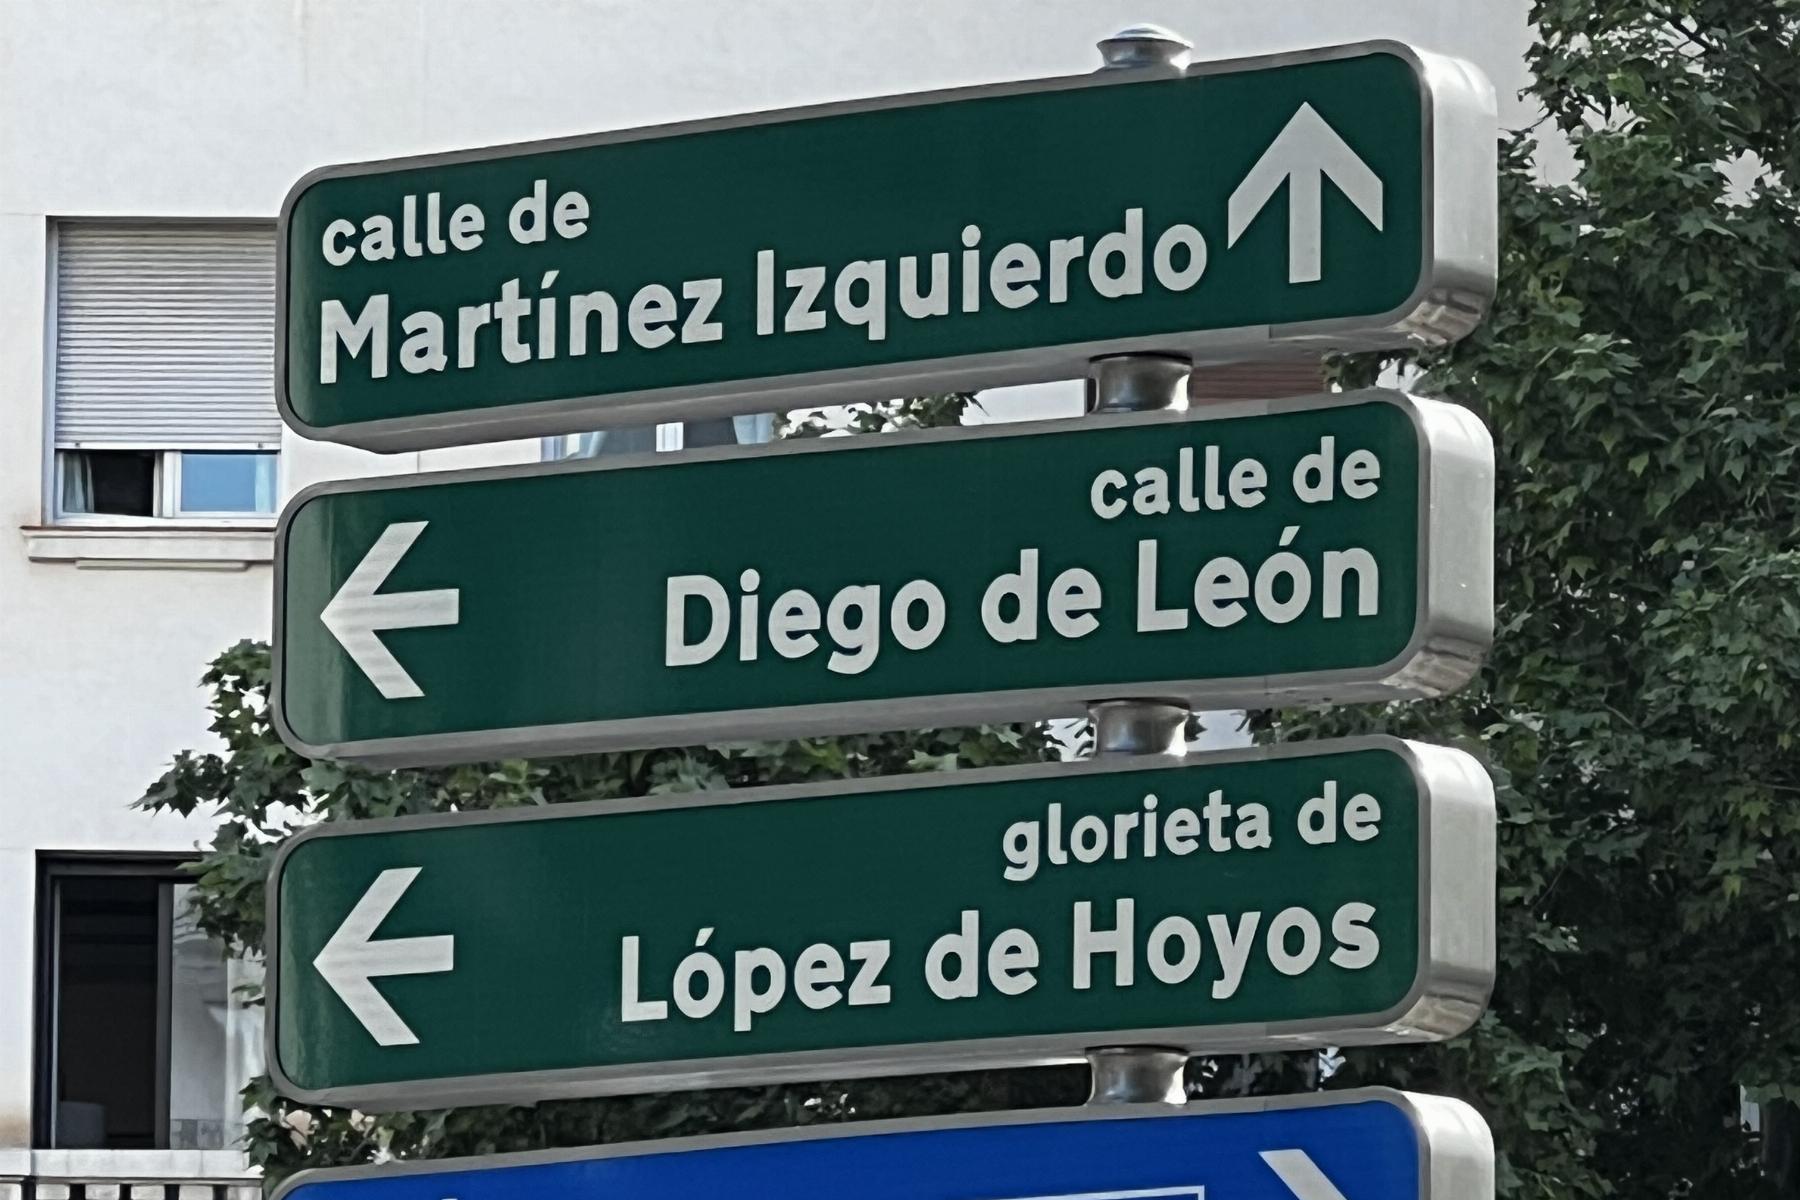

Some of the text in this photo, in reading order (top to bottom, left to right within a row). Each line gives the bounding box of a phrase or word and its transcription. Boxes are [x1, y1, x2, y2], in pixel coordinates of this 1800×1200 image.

[321, 178, 591, 268] calle de
[319, 206, 1208, 385] Martínez Izquierdo
[1089, 434, 1382, 520] calle de
[664, 524, 1380, 676] Diego de León
[1001, 779, 1382, 883] glorieta de
[620, 896, 1381, 1033] López de Hoyos
